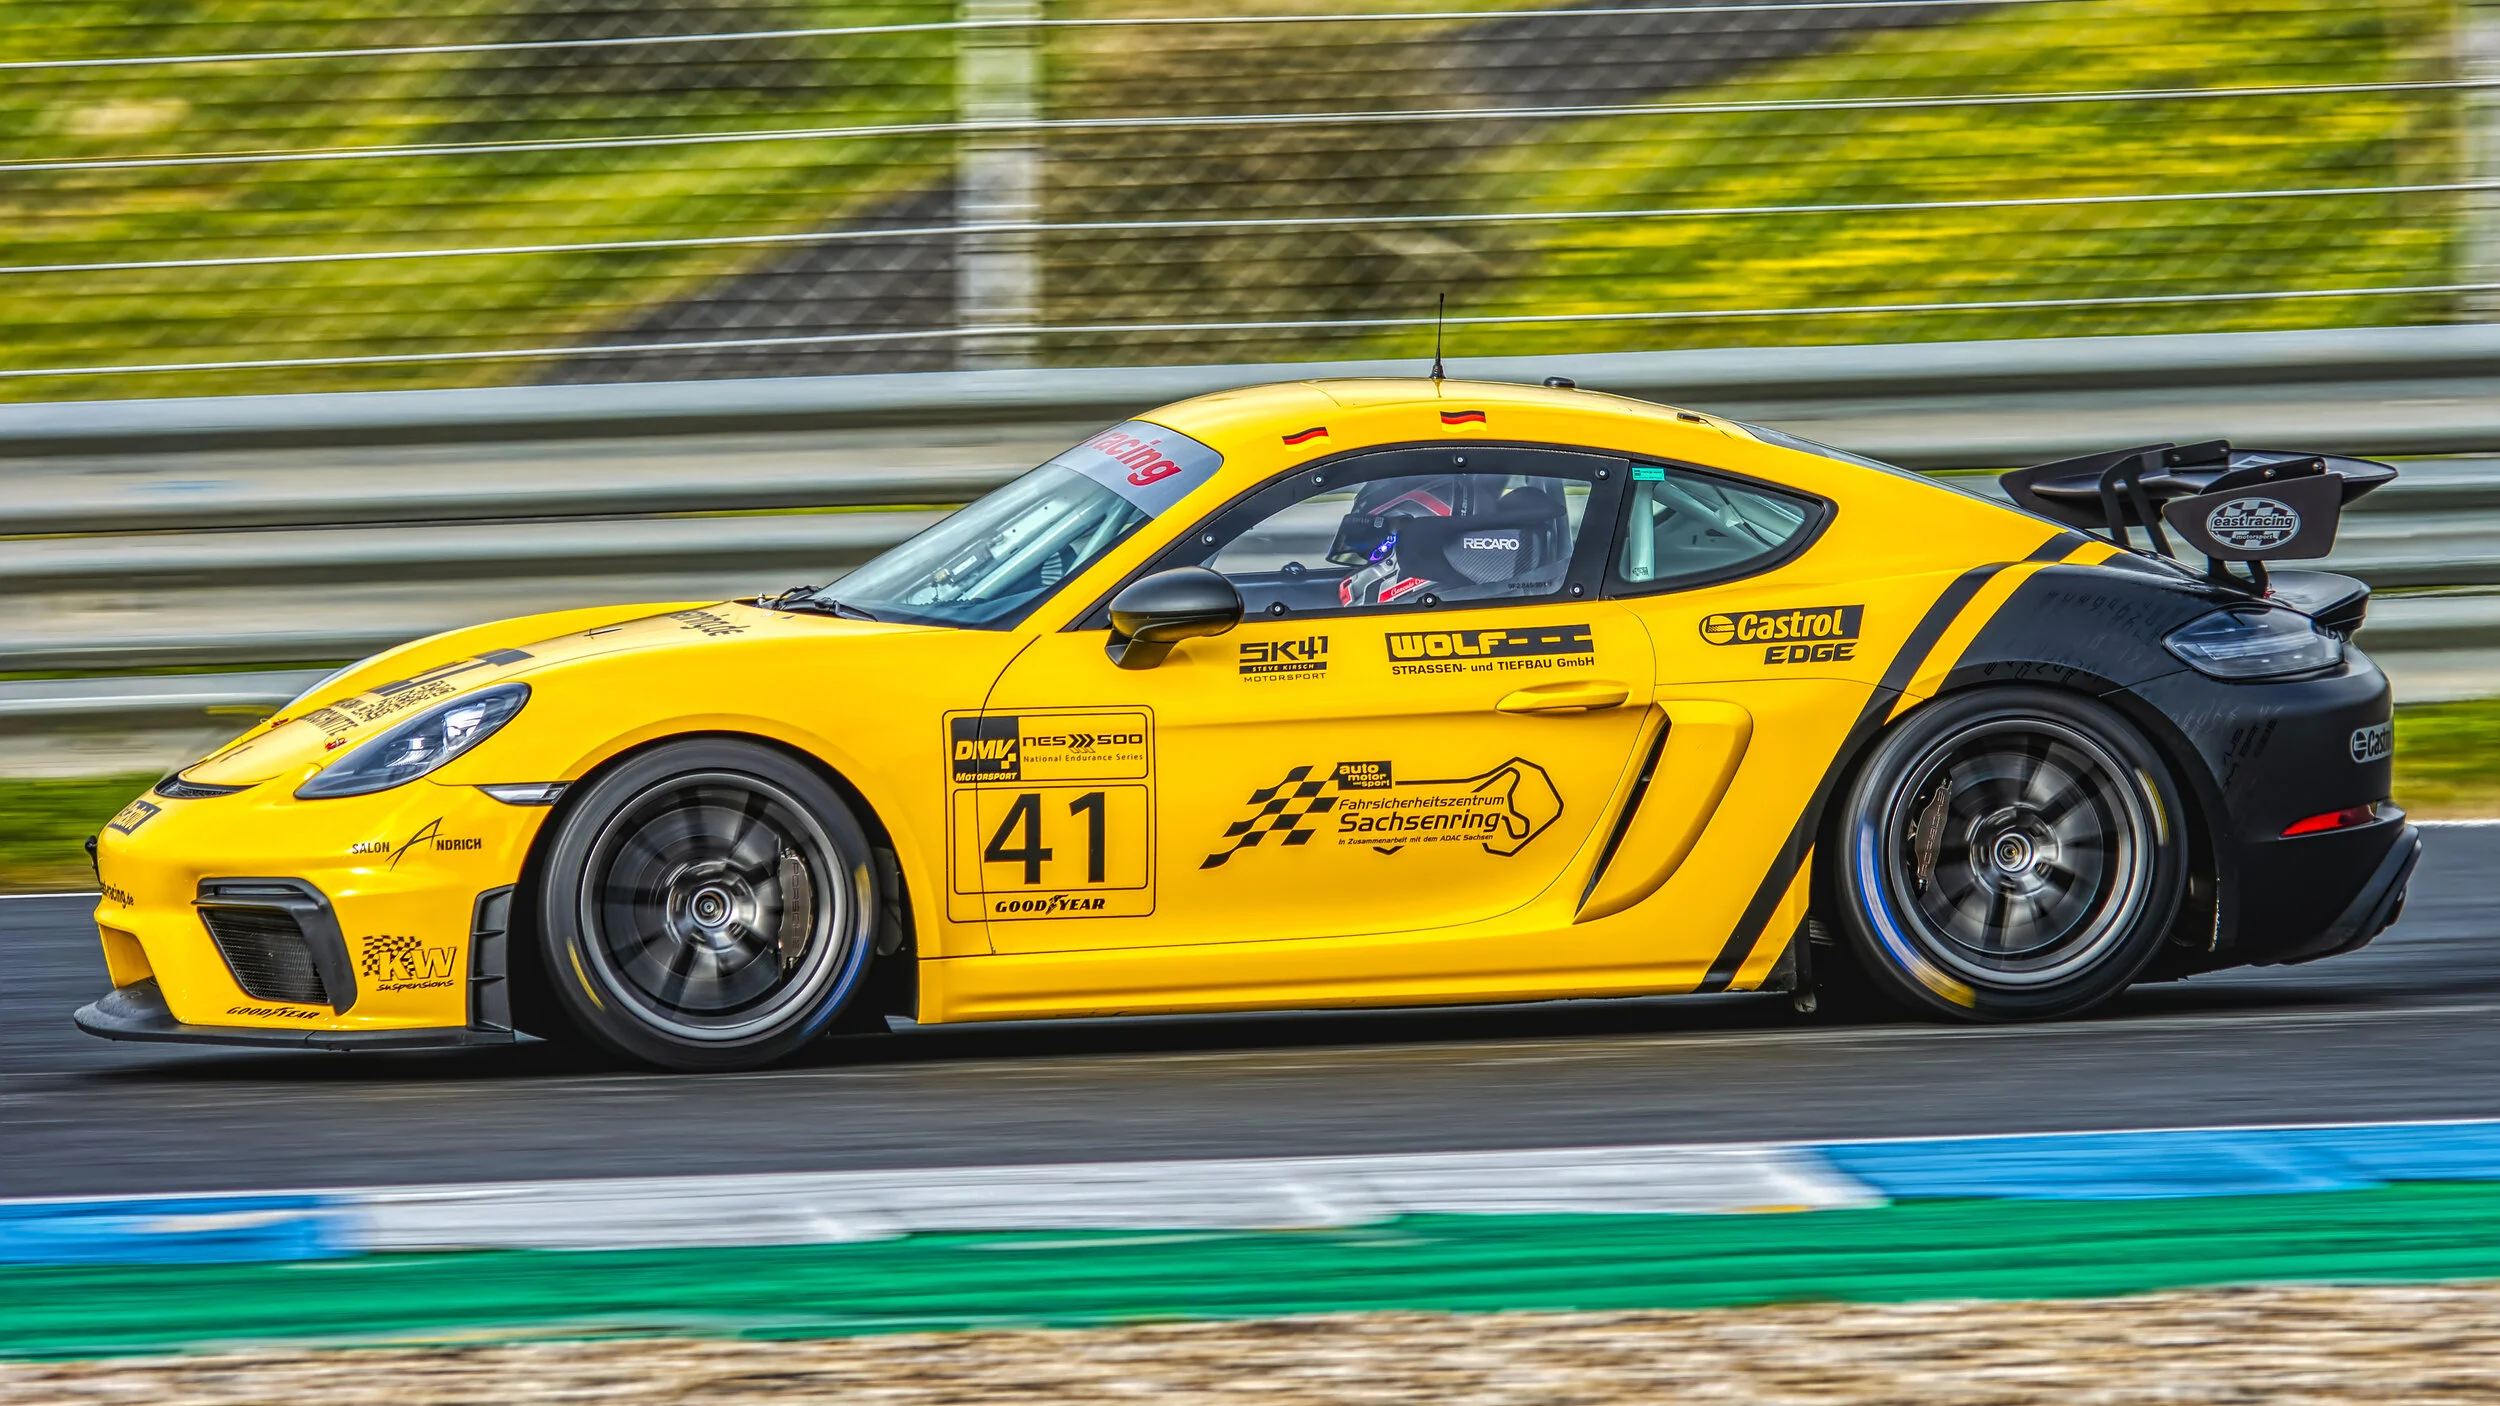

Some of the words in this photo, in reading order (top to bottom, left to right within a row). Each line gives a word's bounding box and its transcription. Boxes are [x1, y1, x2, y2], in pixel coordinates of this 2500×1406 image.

[1463, 538, 1520, 550] RECARO
[1737, 609, 1843, 641] Castrol
[1239, 636, 1328, 663] SK41
[1390, 631, 1507, 658] WOLF
[1764, 642, 1857, 665] EDGE
[1392, 663, 1467, 676] STRASSEN-
[1471, 661, 1494, 673] und
[1499, 658, 1552, 671] TIEFBAU
[1557, 656, 1595, 667] GmbH
[1243, 672, 1326, 683] MOTORSPORT
[1097, 733, 1143, 745] 500
[954, 738, 1017, 761] DMV
[1023, 755, 1062, 763] National
[1065, 753, 1113, 762] Endurance
[1116, 752, 1144, 761] Series
[1339, 763, 1379, 775] auto
[1347, 773, 1387, 782] motor
[1361, 780, 1390, 788] sport
[1339, 796, 1504, 810] Fahrsicherheitszentrum
[1338, 809, 1501, 833] Sachsenring
[984, 792, 1105, 885] 41
[1348, 837, 1408, 845] Zusammenarbeit
[1440, 834, 1461, 842] ADAC
[1463, 833, 1494, 841] Sachsen
[352, 842, 390, 854] SALON
[378, 947, 457, 982] KW
[376, 980, 454, 993] suspensions
